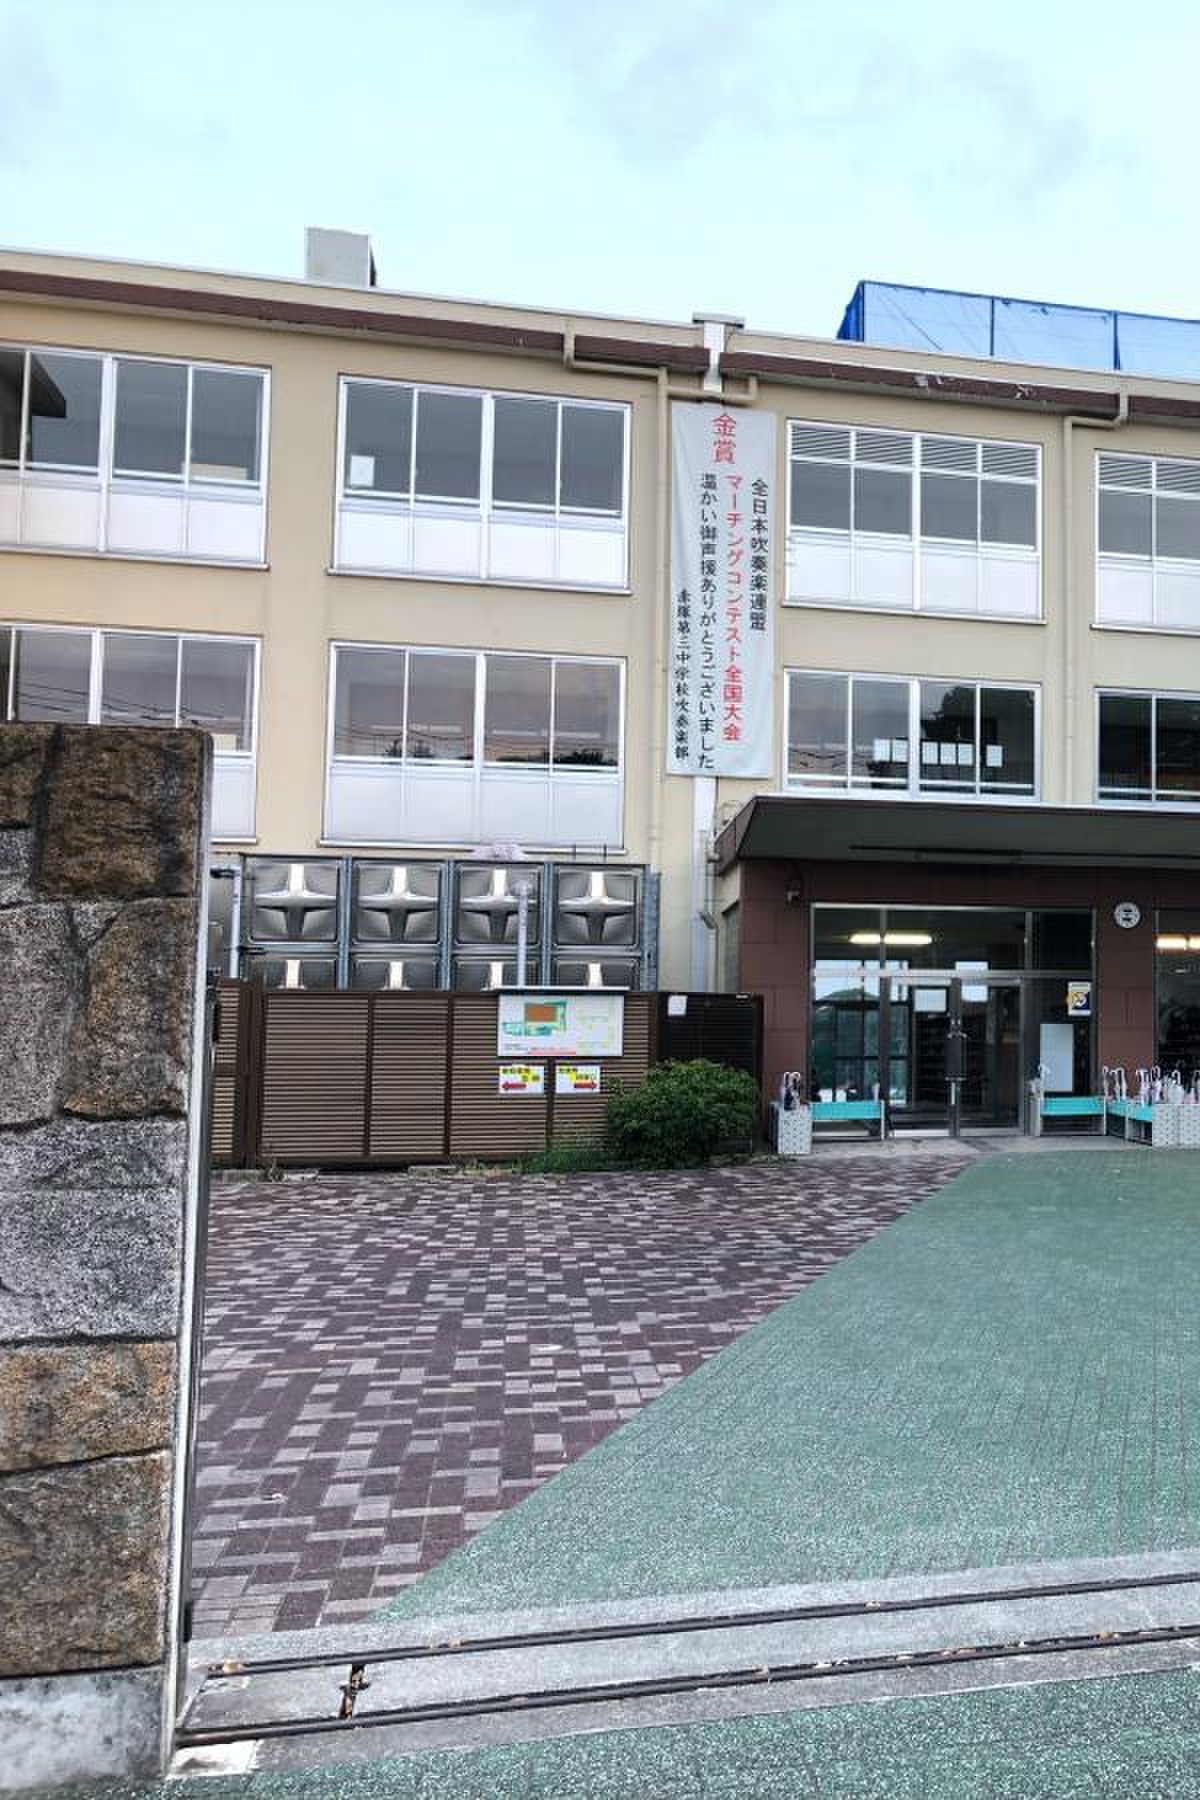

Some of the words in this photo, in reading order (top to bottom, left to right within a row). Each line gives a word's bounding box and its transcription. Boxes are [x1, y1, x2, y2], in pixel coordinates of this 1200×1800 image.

[712, 413, 737, 465] 金賞
[722, 474, 745, 741] マーチングコンテスト全国大会
[750, 478, 769, 631] 全日本吹奏楽連盟
